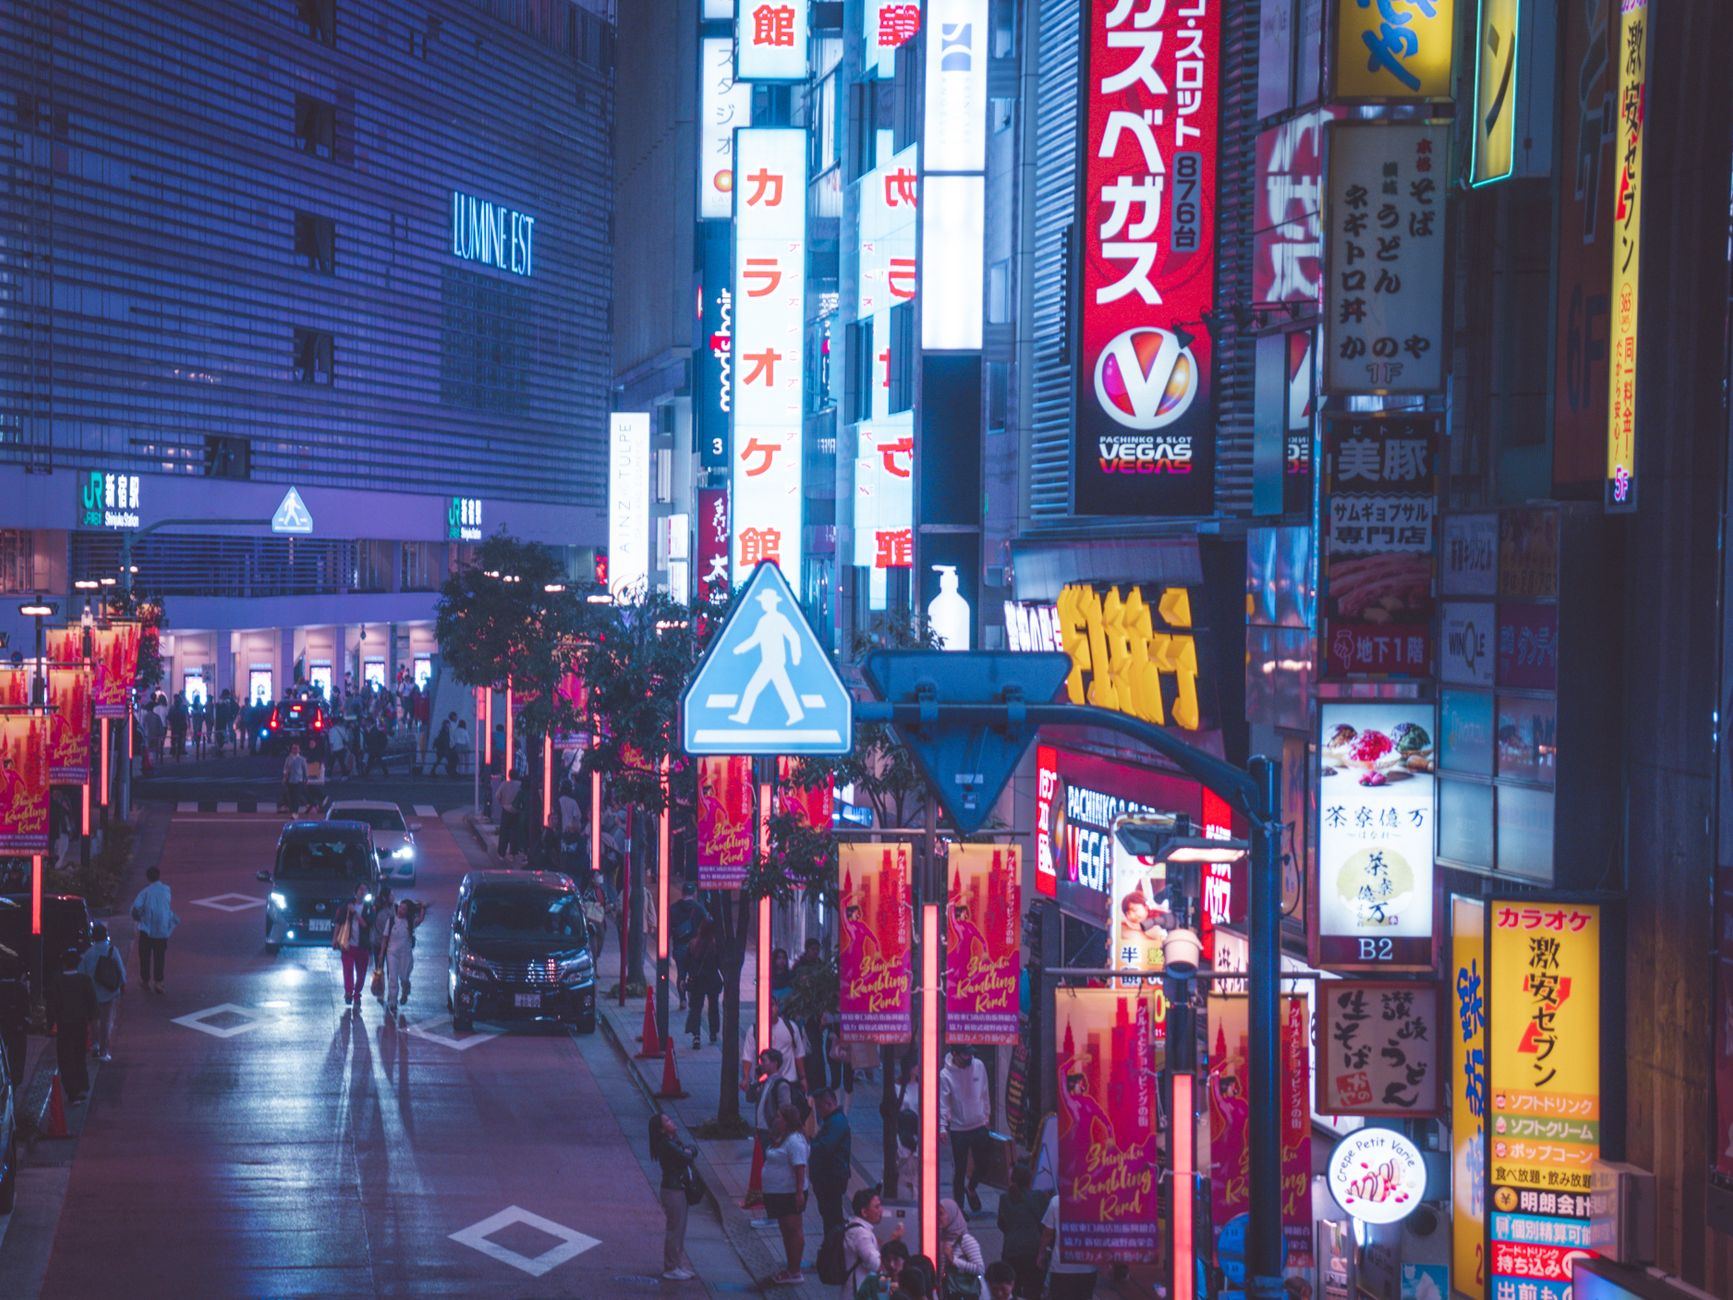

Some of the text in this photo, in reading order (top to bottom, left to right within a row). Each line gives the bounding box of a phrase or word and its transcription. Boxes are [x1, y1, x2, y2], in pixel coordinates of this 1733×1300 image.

[752, 4, 795, 46] 館
[1174, 155, 1197, 248] 876台
[453, 191, 535, 276] LUMINE EST
[1340, 335, 1431, 360] かのや
[739, 167, 784, 568] カラオケ館
[713, 438, 723, 455] 3
[1099, 443, 1192, 460] VEGAS
[1100, 436, 1192, 444] PACHINKO & SLOT
[1338, 438, 1428, 481] 美豚
[84, 471, 102, 509] JR
[105, 473, 139, 508] 新宿駅
[1614, 466, 1629, 501] 5F
[448, 497, 460, 525] JR
[1335, 526, 1427, 544] 専門店
[1357, 635, 1424, 664] 地下1階
[1497, 907, 1592, 932] カラオケ
[1358, 938, 1393, 960] B2
[849, 968, 909, 999] Rambling
[956, 967, 1016, 999] Rambling
[1528, 936, 1561, 1087] 激安セブン
[1334, 989, 1372, 1069] 生そば
[1381, 990, 1429, 1107] 讃岐うどん
[1511, 1095, 1593, 1115] ソフトドリンク
[1511, 1119, 1593, 1140] ソフトクリーム
[1337, 1137, 1415, 1182] Crepe Petit Varie
[1510, 1142, 1593, 1164] ポップコーン
[1073, 1164, 1152, 1200] Rambling
[1100, 1189, 1143, 1222] Road
[1520, 1191, 1592, 1217] 明朗会計
[1497, 1255, 1562, 1278] 持ち込み
